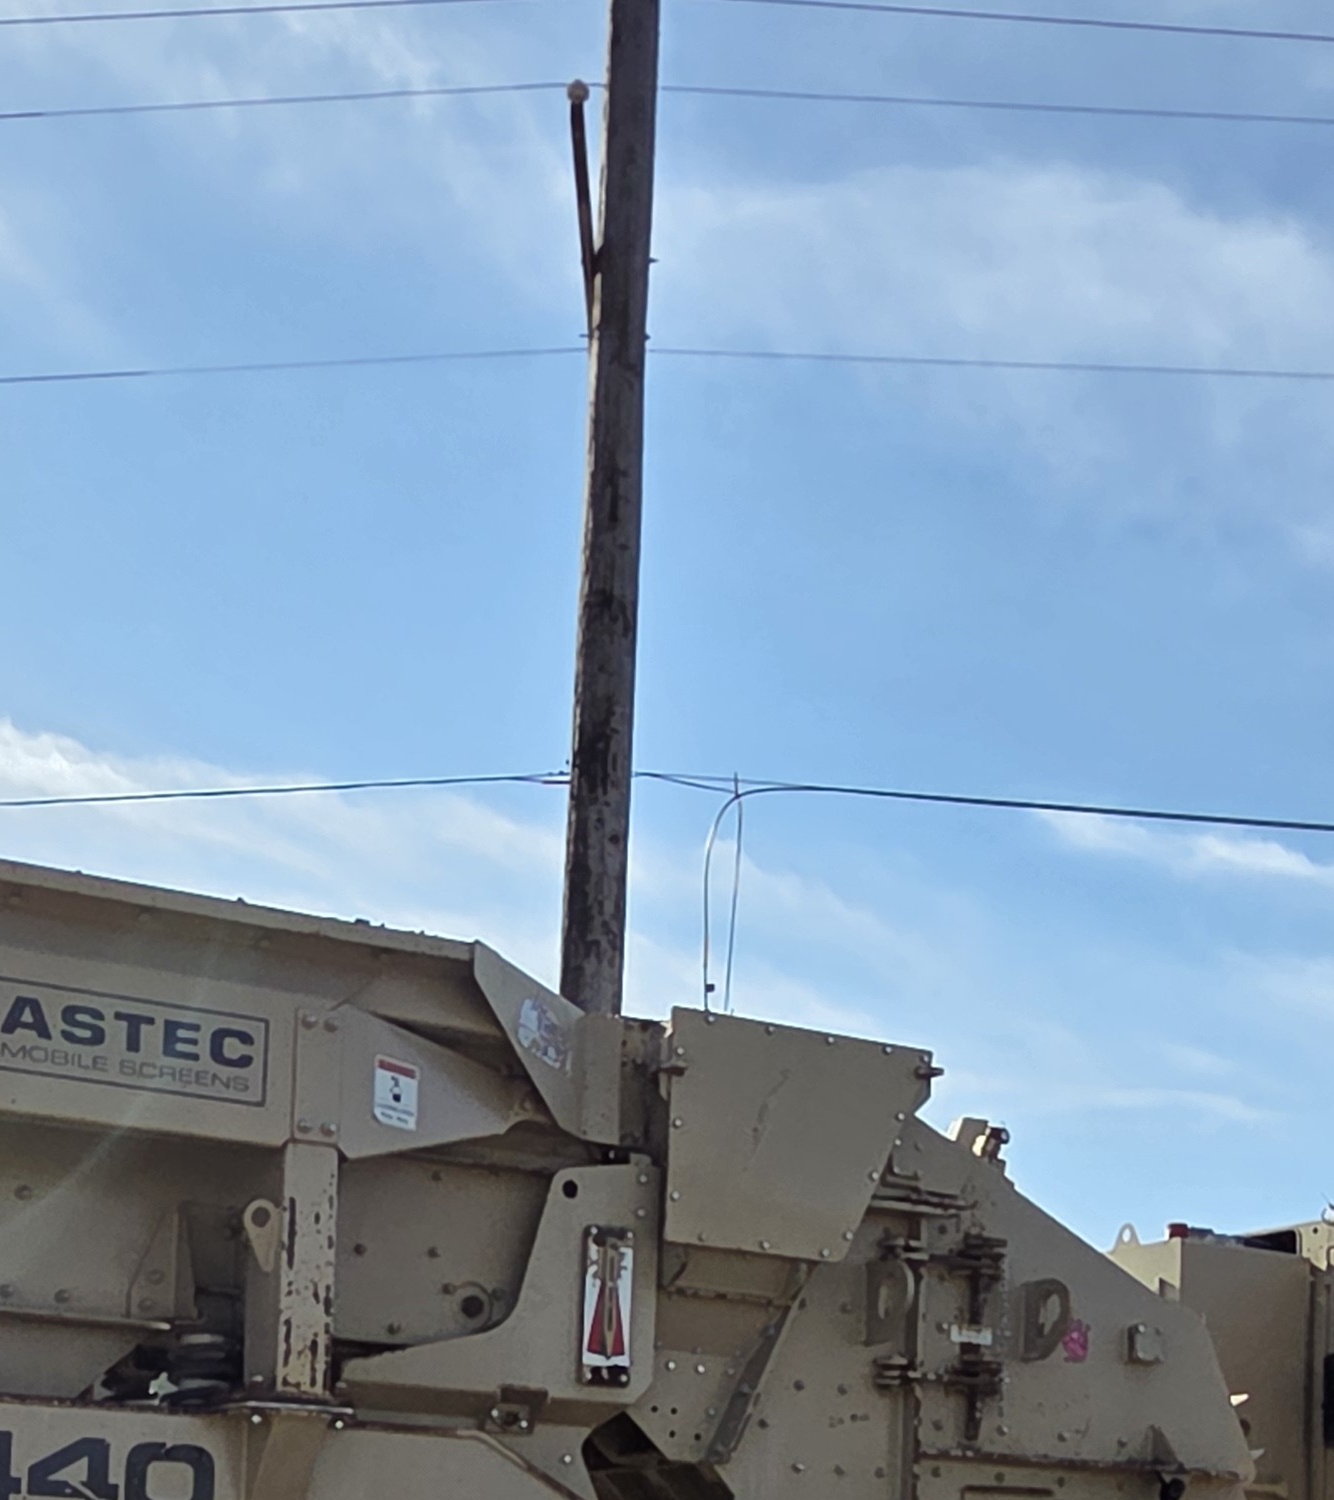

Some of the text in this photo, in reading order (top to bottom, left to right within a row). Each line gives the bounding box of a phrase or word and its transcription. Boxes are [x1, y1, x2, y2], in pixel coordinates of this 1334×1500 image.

[0, 996, 255, 1069] ASTEC
[0, 1042, 250, 1093] MOBILE SCREENS
